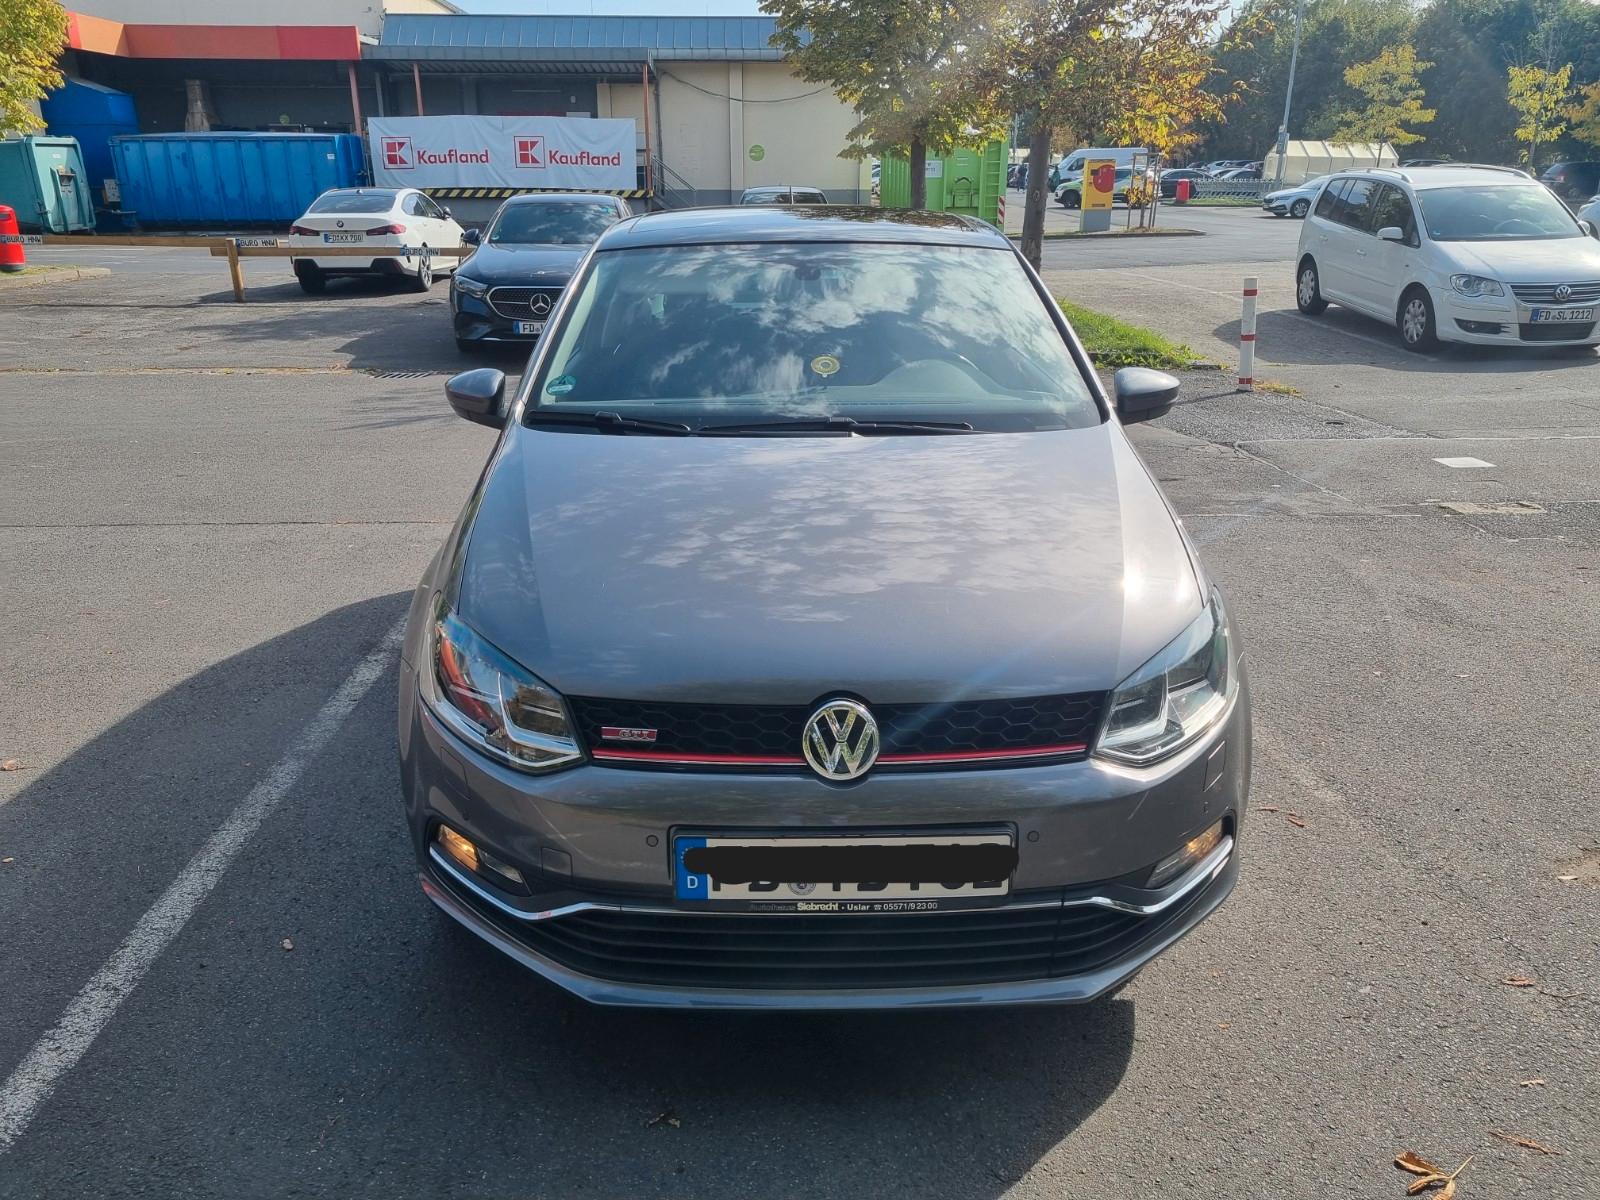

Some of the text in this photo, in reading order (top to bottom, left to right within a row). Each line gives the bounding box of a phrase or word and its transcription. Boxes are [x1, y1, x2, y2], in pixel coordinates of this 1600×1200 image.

[417, 149, 489, 165] Kaufland
[548, 150, 621, 166] Kaufland
[1539, 310, 1590, 320] FD SL 1212
[522, 323, 535, 333] FD
[686, 876, 699, 889] D
[797, 902, 839, 911] Siebrecht
[847, 903, 870, 911] Uslar
